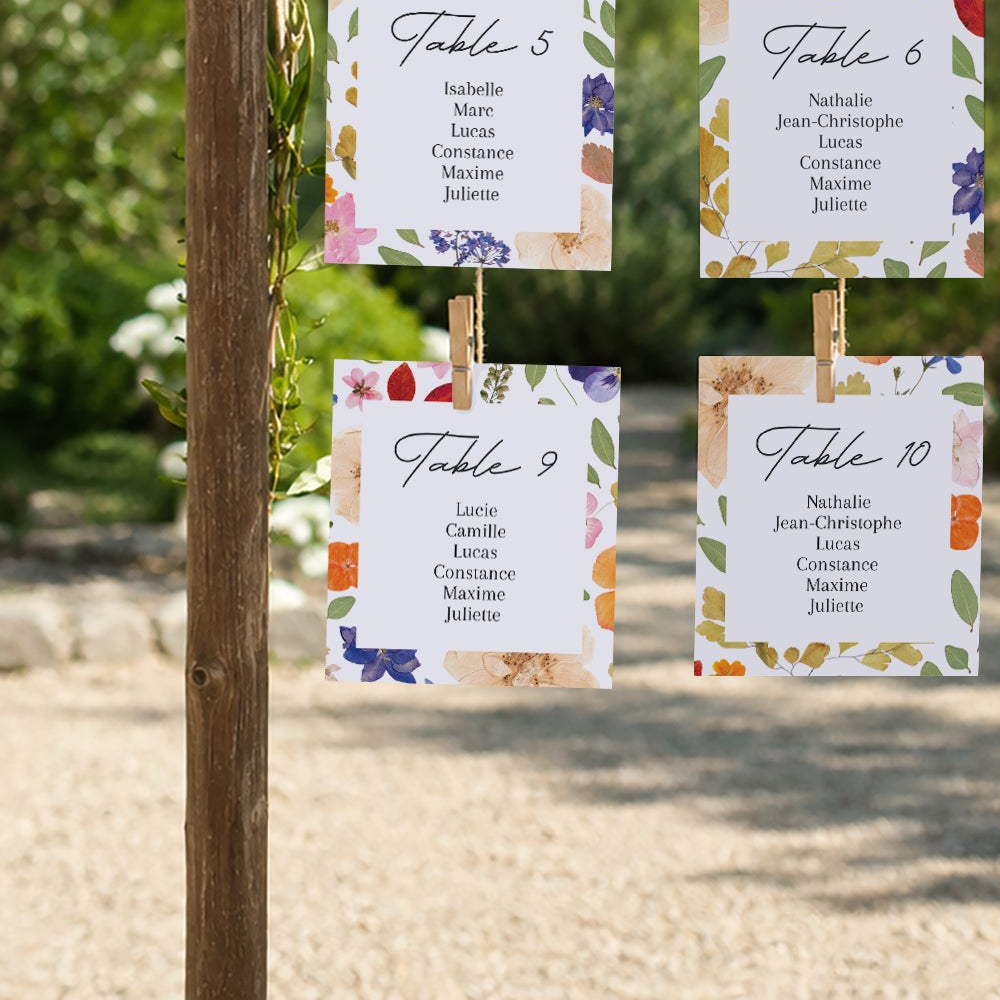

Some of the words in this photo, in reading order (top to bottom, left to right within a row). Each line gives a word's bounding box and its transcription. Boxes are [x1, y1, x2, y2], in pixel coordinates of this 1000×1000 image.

[390, 9, 519, 68] Table
[530, 29, 555, 57] 5
[762, 22, 890, 81] Table
[904, 38, 924, 66] 6
[444, 81, 504, 97] Isabelle
[809, 92, 873, 108] Nathalie
[454, 102, 494, 118] Marc
[451, 122, 496, 139] Lucas
[775, 113, 904, 133] Jean-Christophe
[818, 134, 863, 149] Lucas
[431, 143, 514, 161] Constance
[799, 155, 882, 170] Constance
[441, 164, 504, 181] Maxime
[809, 175, 872, 191] Maxime
[442, 185, 500, 203] Juliette
[811, 196, 868, 215] Juliette
[393, 430, 522, 489] Table
[537, 450, 558, 478] 9
[755, 423, 884, 482] Table
[896, 440, 932, 469] 10
[456, 501, 498, 518] Lucie
[806, 494, 871, 510] Nathalie
[445, 522, 506, 539] Camille
[772, 514, 902, 534] Jean-Christophe
[453, 543, 498, 560] Lucas
[816, 535, 860, 551] Lucas
[433, 563, 516, 581] Constance
[796, 556, 879, 572] Constance
[443, 585, 506, 602] Maxime
[806, 577, 868, 593] Maxime
[444, 606, 501, 624] Juliette
[807, 598, 864, 616] Juliette
